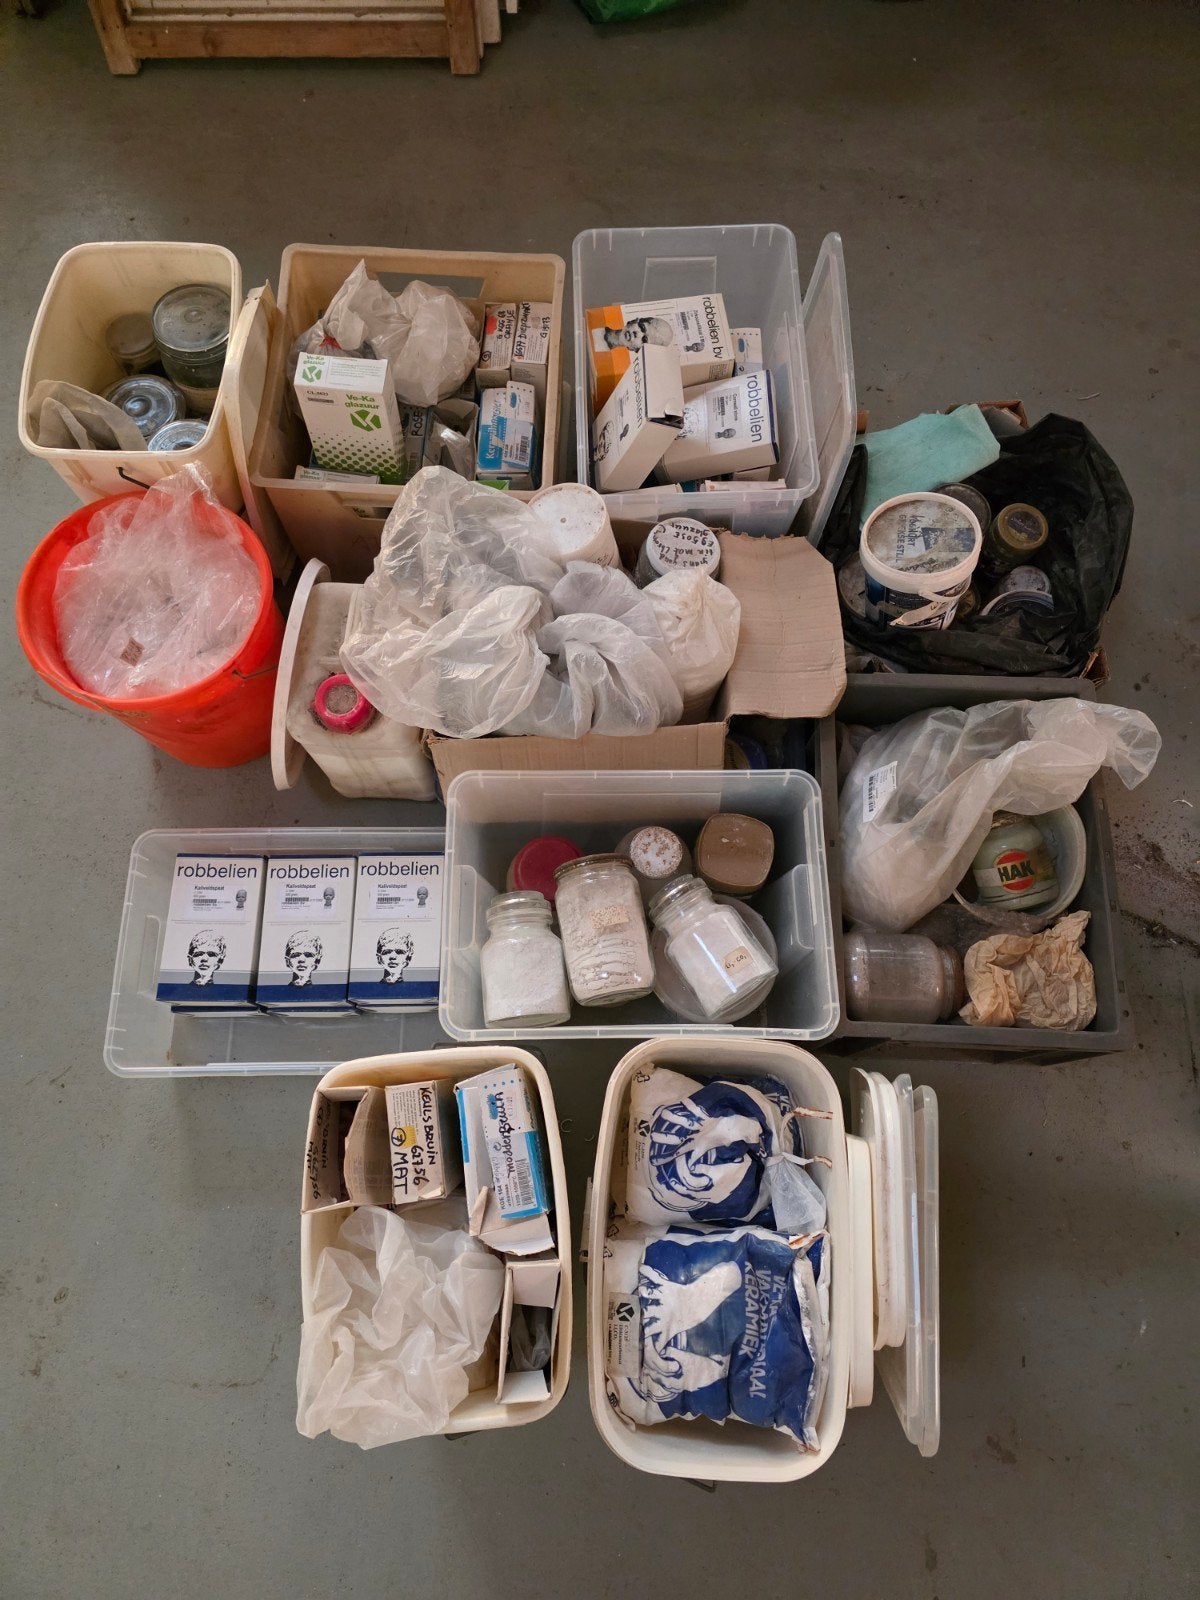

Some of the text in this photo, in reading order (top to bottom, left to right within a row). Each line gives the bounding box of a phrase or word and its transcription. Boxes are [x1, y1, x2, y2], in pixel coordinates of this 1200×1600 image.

[702, 296, 724, 360] robbelien bv
[345, 394, 376, 402] Ve-Ka
[345, 402, 380, 410] glazuur
[746, 374, 763, 442] robbelien
[670, 522, 710, 537] glazuur
[177, 862, 258, 879] robbelien
[270, 864, 350, 880] robbelien
[360, 861, 440, 877] robbelien
[996, 859, 1036, 884] HAK
[393, 1152, 409, 1195] MAT
[738, 1261, 759, 1360] KERAMIEK
